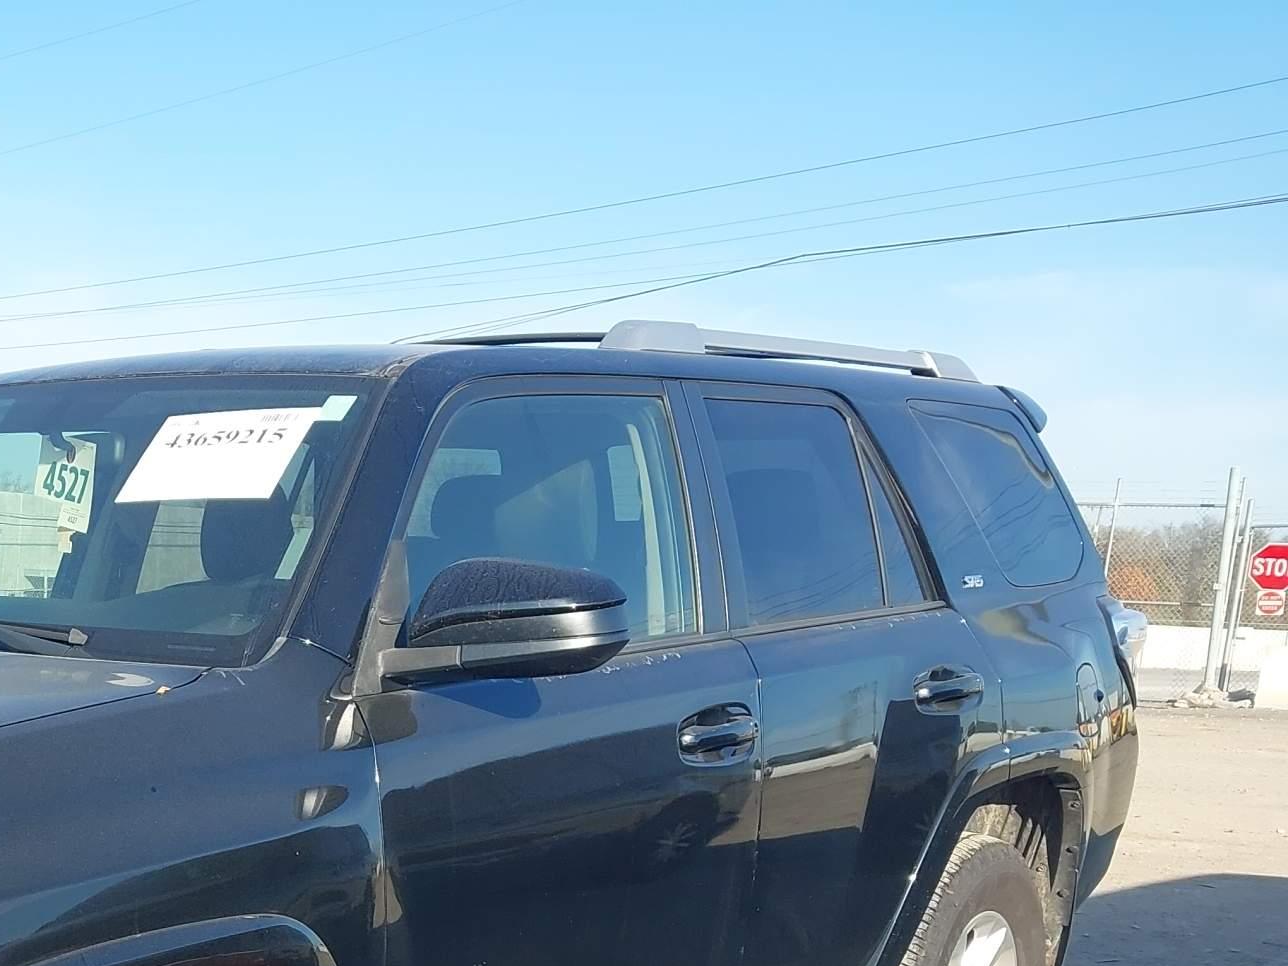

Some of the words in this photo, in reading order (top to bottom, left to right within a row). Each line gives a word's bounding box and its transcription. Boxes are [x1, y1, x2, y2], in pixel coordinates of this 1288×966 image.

[165, 428, 288, 448] 43659215
[43, 461, 90, 504] 4527
[1252, 557, 1288, 577] STO
